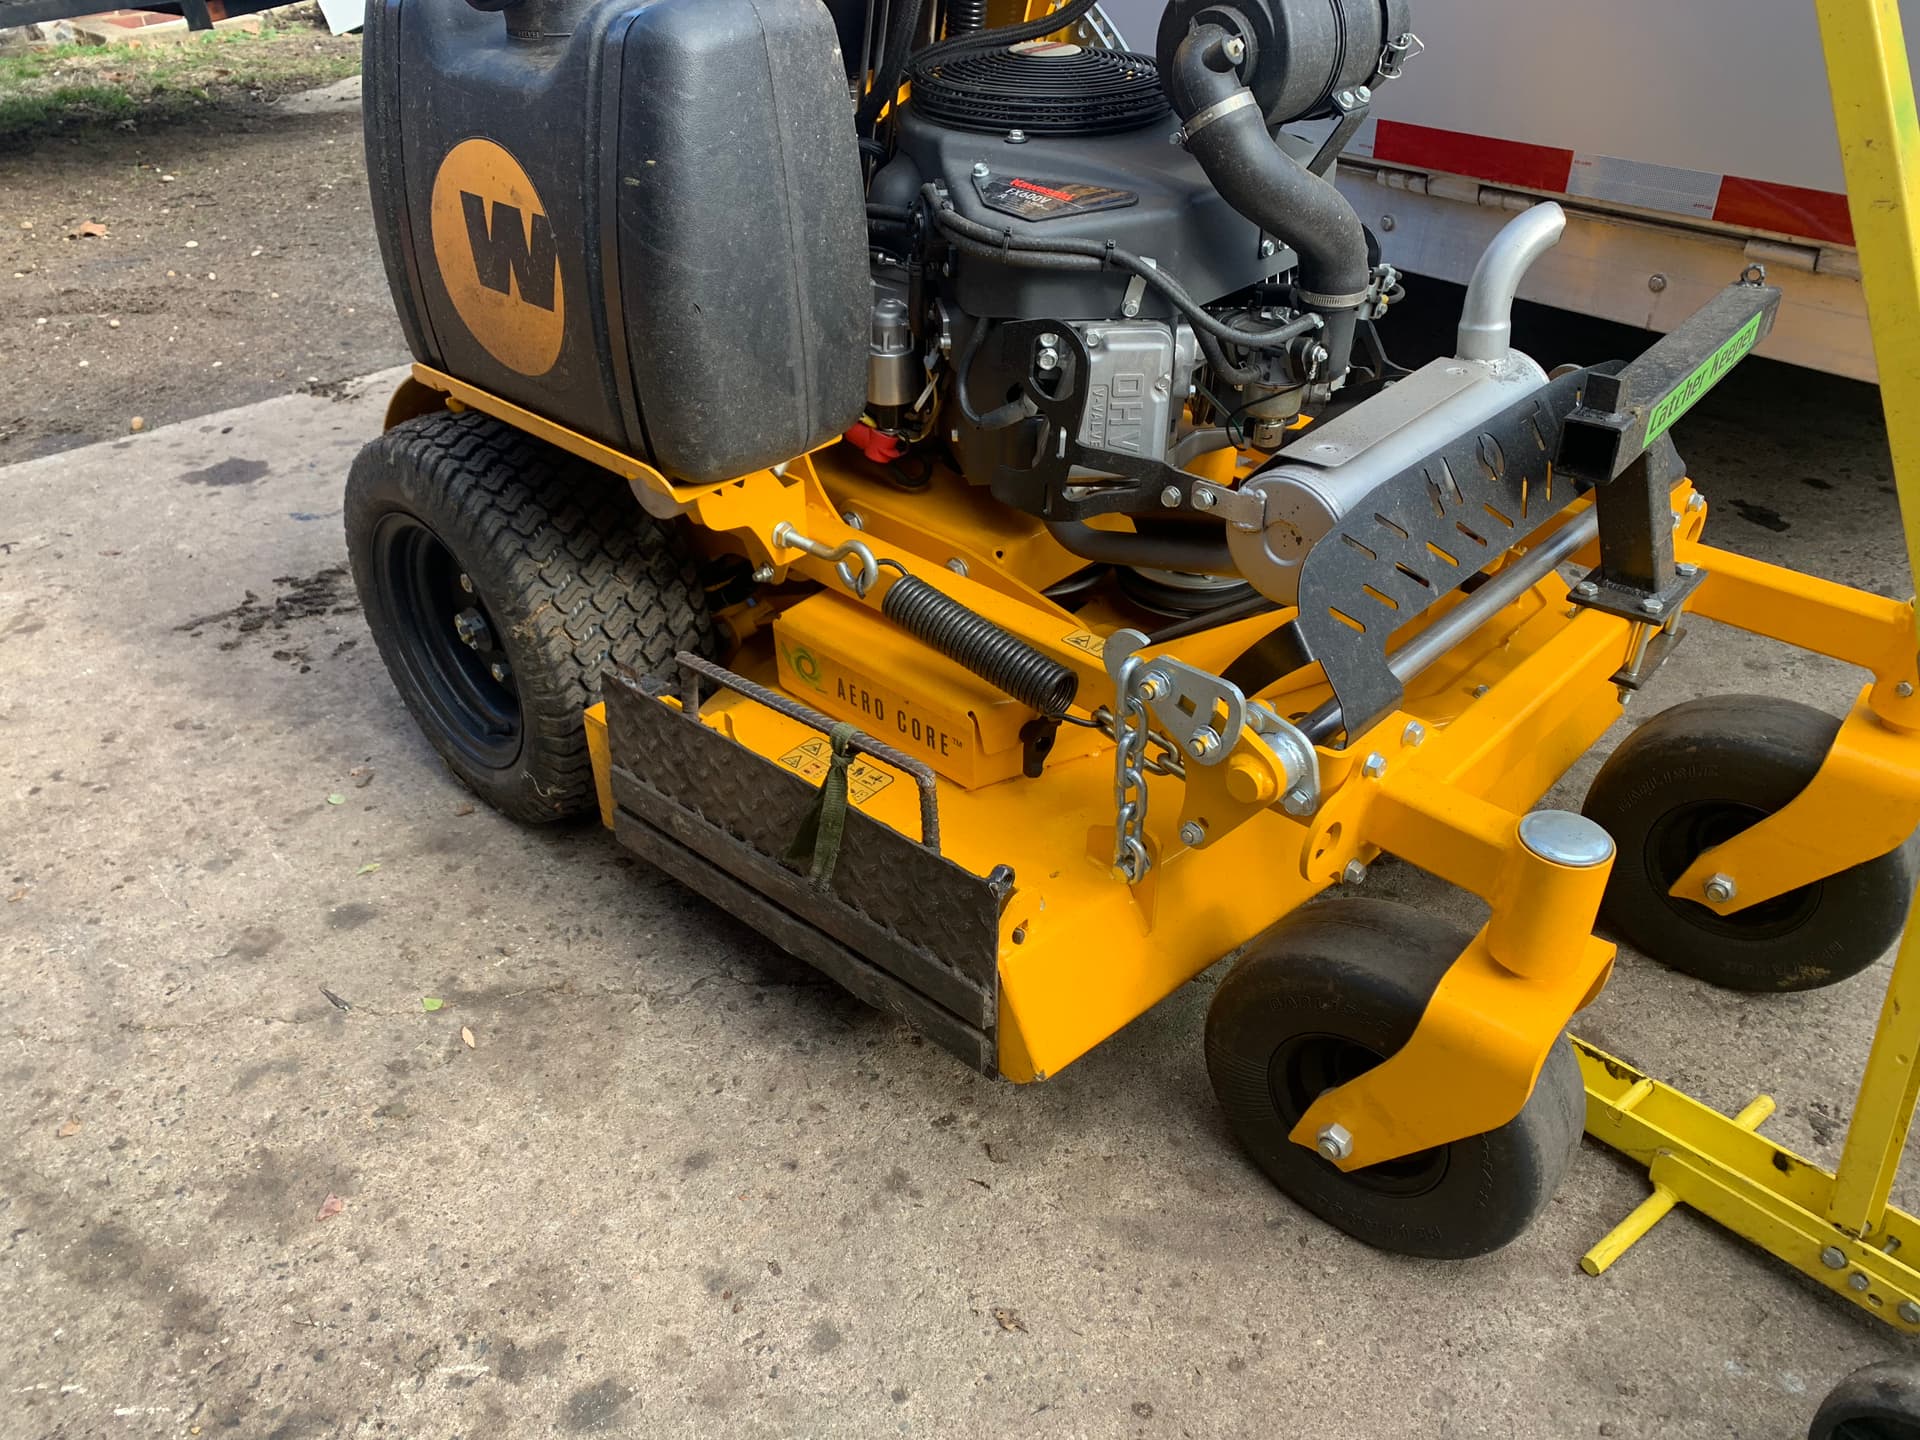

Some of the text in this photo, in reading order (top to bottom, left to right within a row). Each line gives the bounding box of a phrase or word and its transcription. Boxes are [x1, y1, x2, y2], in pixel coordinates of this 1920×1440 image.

[1005, 187, 1052, 204] FX600V
[460, 190, 559, 313] W
[1089, 387, 1105, 448] V-VALVE
[1108, 373, 1144, 454] OHV
[1648, 322, 1758, 436] Catcher Keeper
[1423, 399, 1547, 519] HOT
[837, 677, 884, 721] AERO
